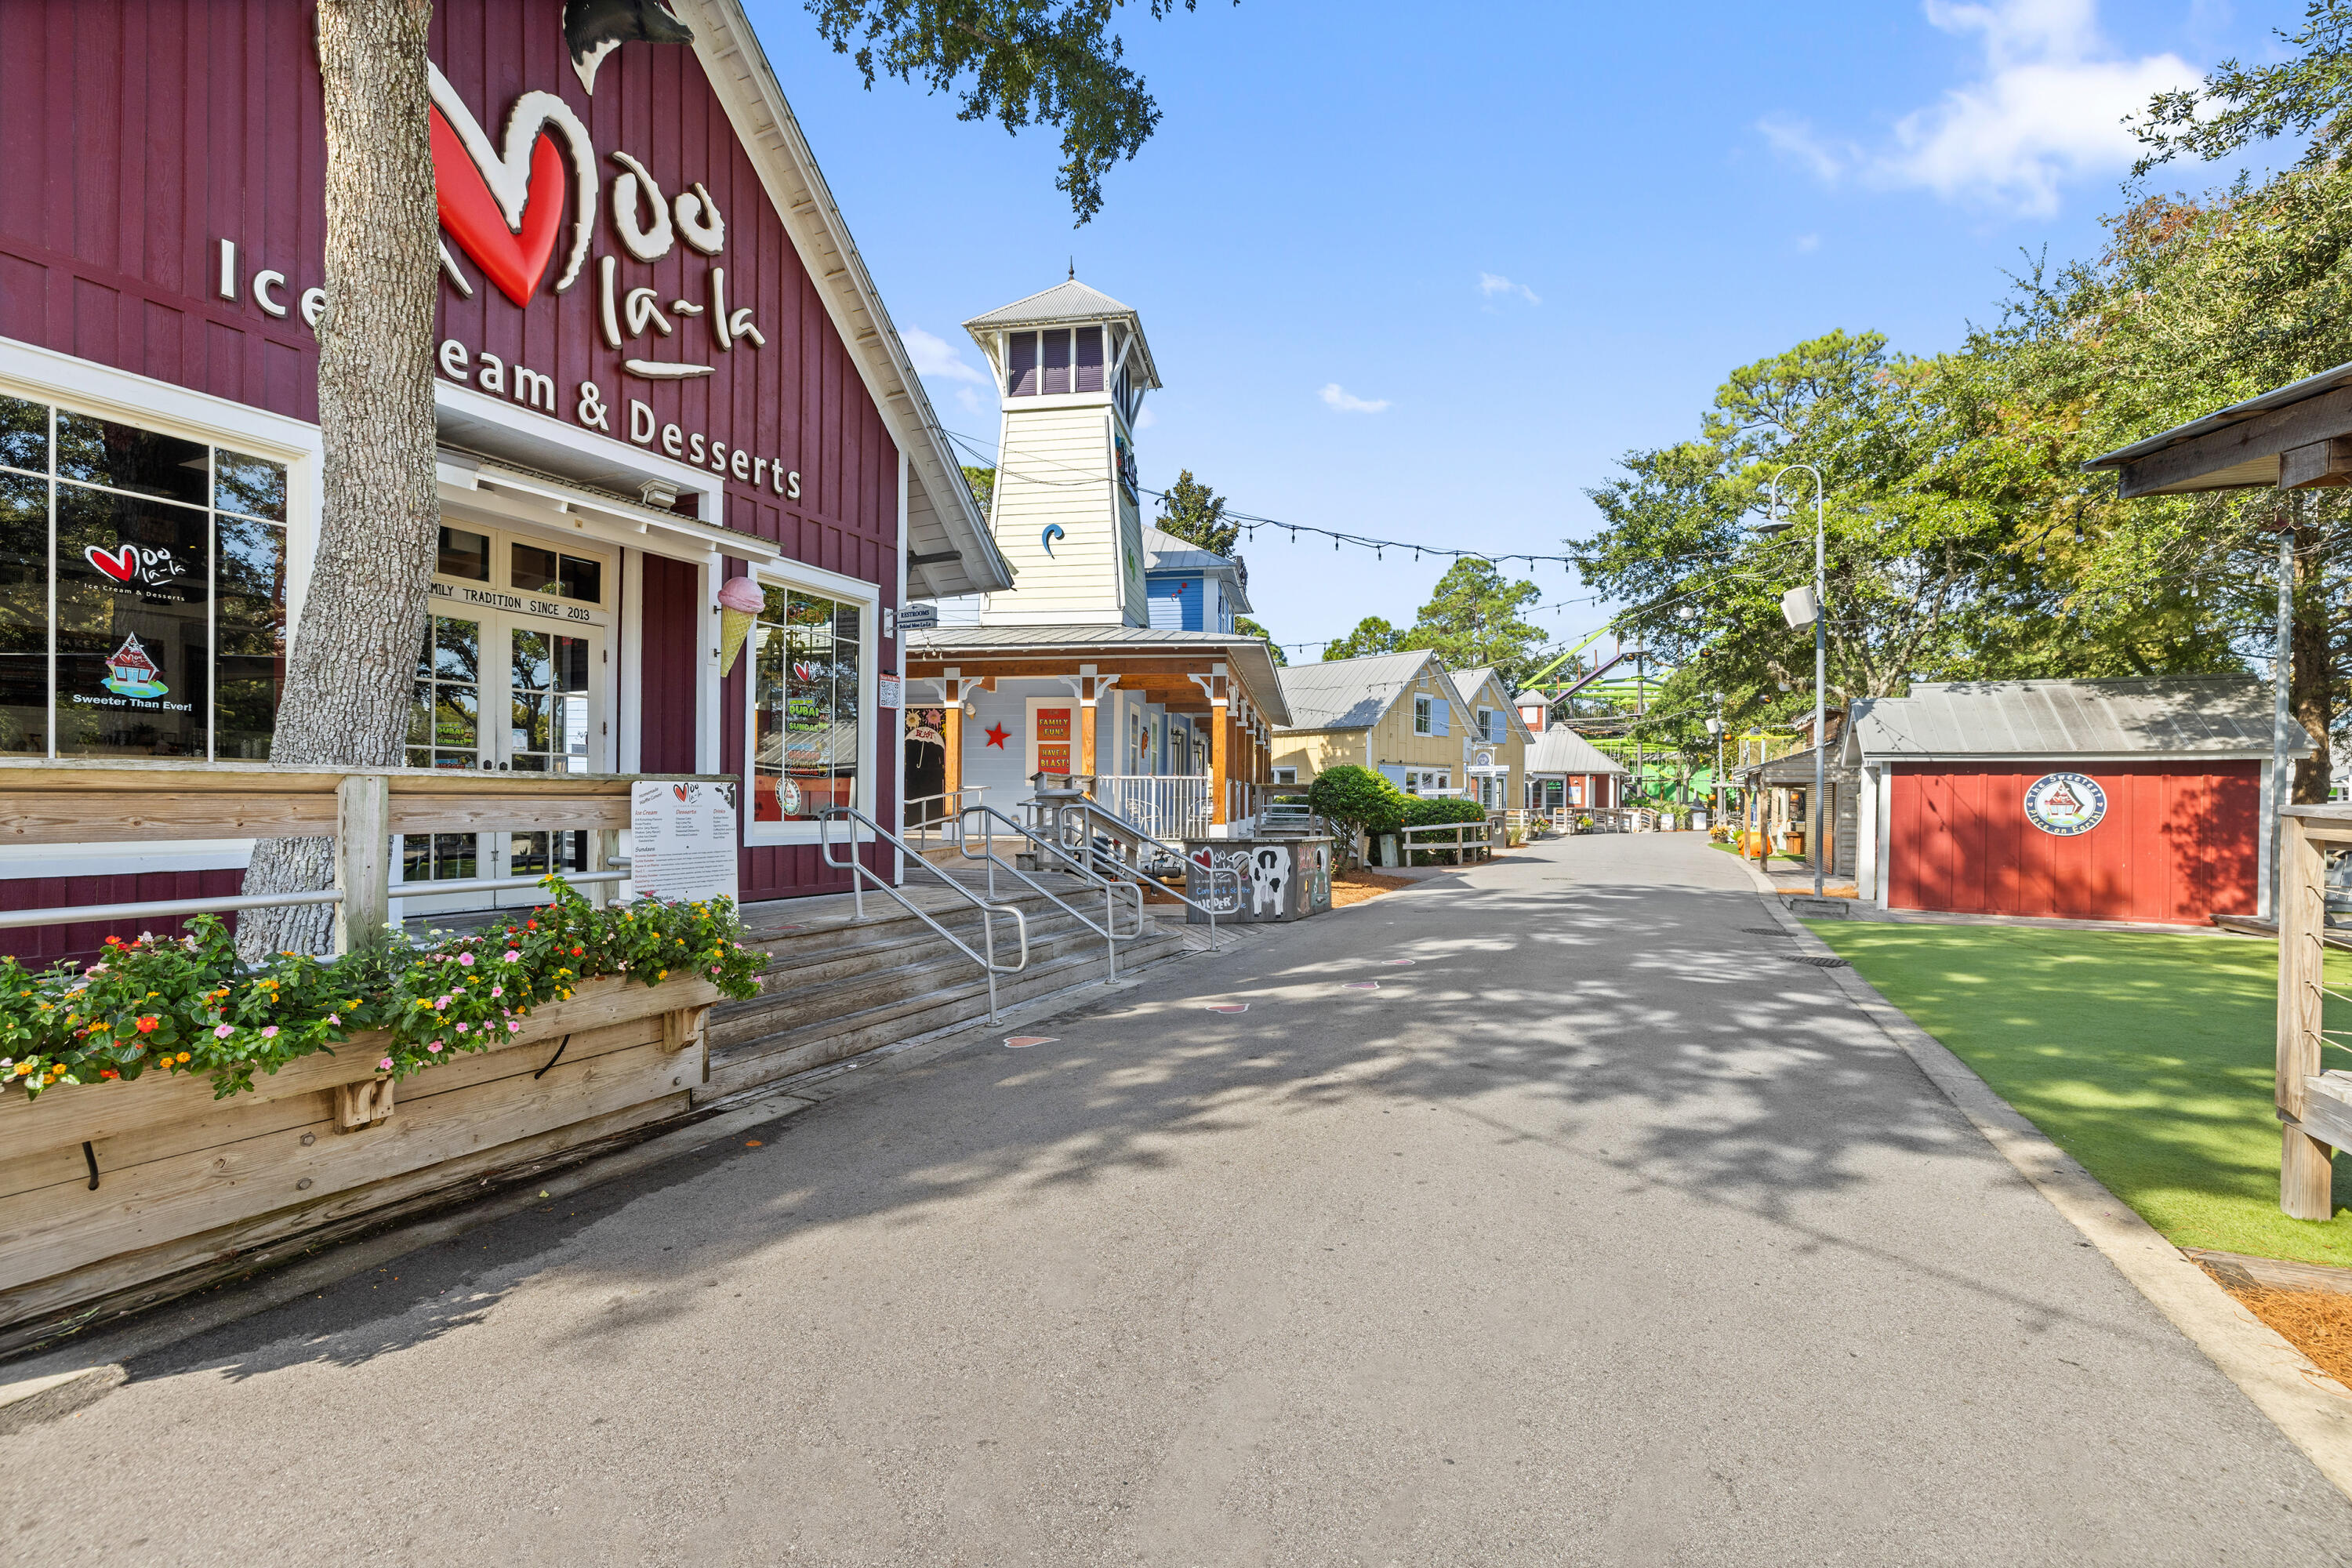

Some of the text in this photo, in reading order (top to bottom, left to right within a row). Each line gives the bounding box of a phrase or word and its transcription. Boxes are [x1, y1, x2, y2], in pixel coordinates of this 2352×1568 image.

[219, 238, 801, 499] Ice eam & Desserts
[103, 585, 132, 593] Cream
[146, 591, 185, 601] Desserts
[463, 588, 521, 608] TRADITION
[530, 600, 559, 615] SINCE
[568, 607, 590, 620] 2013
[786, 604, 824, 624] OPEN
[900, 609, 930, 619] RESTROOMS
[73, 694, 192, 712] Sweeter Than Ever!
[789, 705, 819, 717] DUBAI
[789, 722, 818, 732] SUNDAE
[1039, 718, 1069, 727] FAMILY
[1040, 759, 1069, 768] BLAST!
[2028, 774, 2102, 798] The Sweetest
[2028, 810, 2049, 830] Place
[2072, 811, 2102, 833] Earth!
